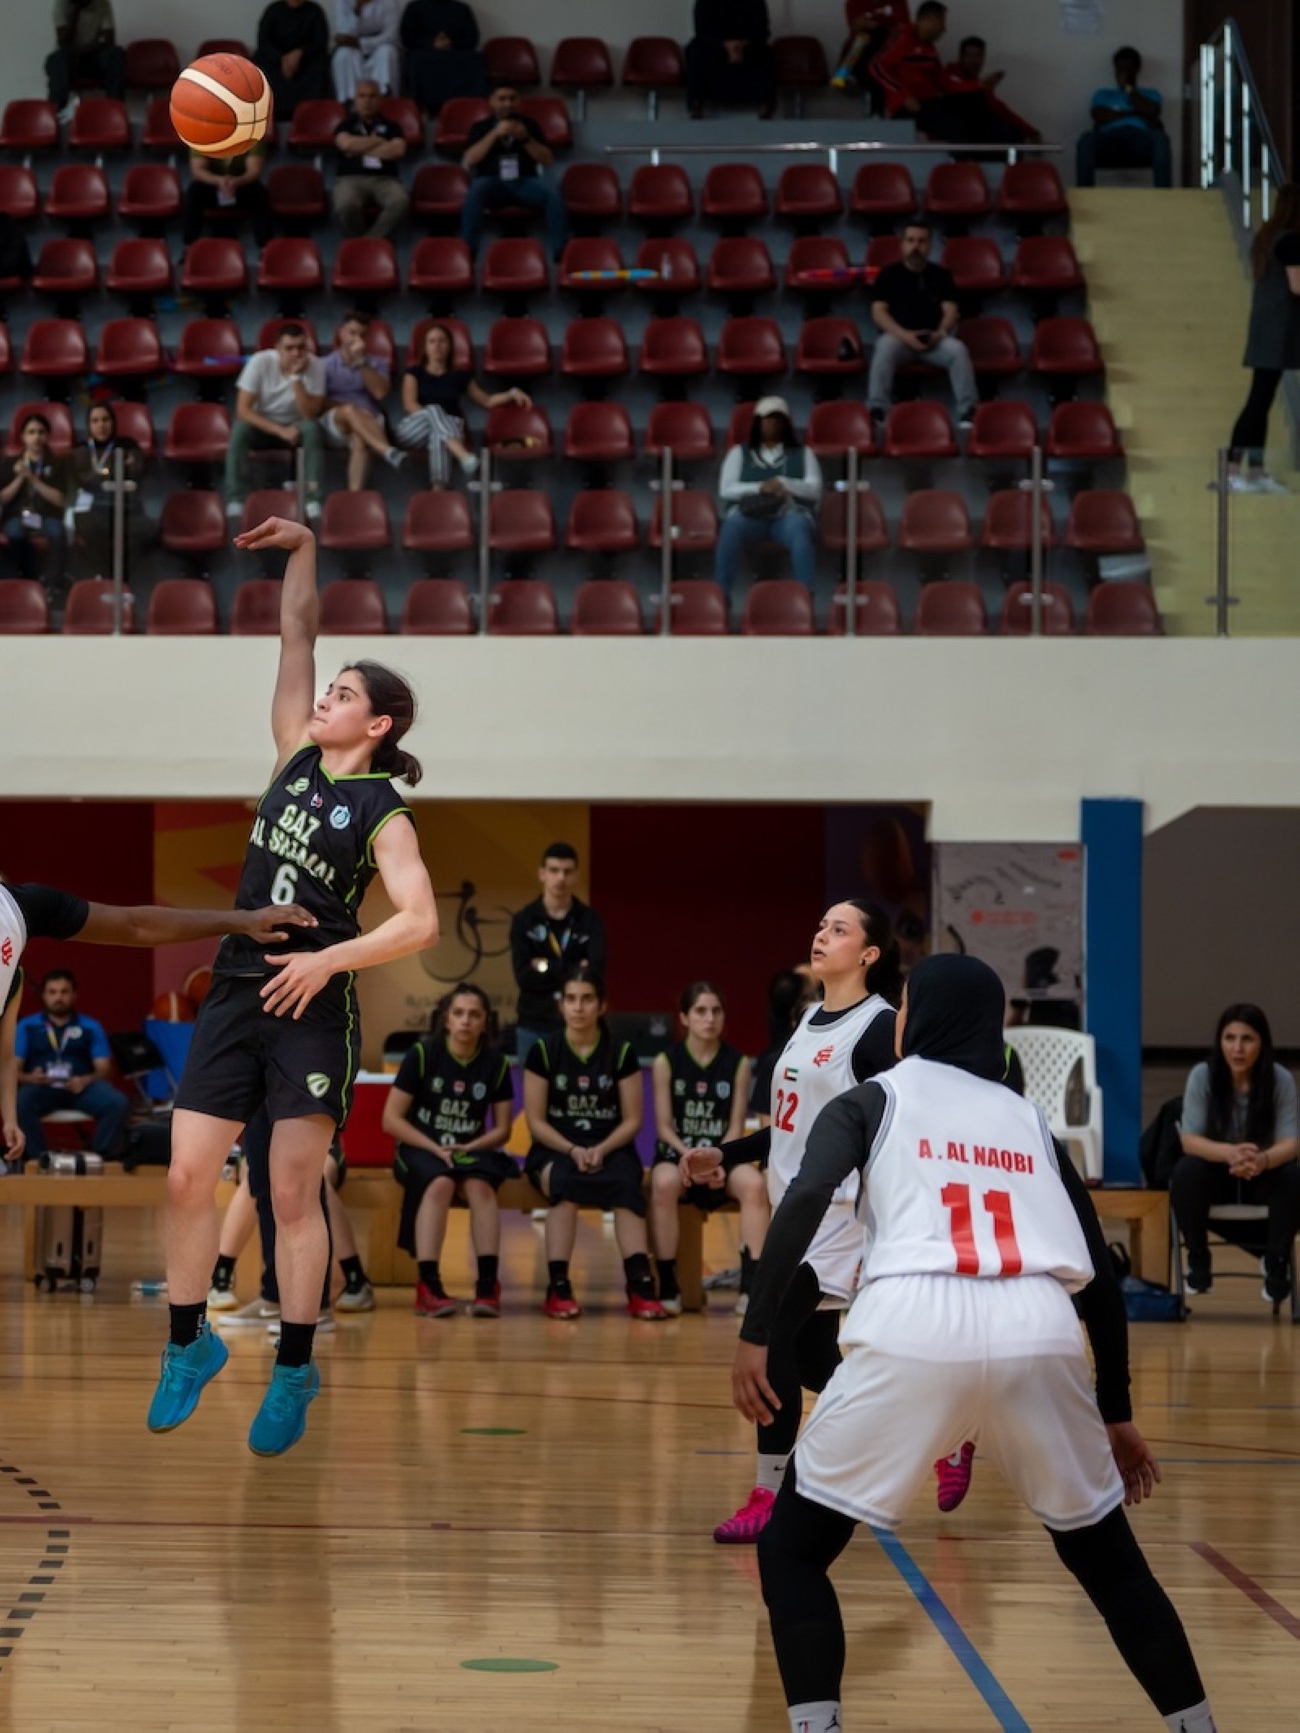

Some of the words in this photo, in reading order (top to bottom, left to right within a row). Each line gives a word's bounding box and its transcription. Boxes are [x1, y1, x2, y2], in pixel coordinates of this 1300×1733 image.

[278, 804, 321, 848] GAZ
[271, 863, 299, 906] 6
[440, 1097, 471, 1119] GAZ
[684, 1099, 716, 1119] GAZ
[947, 1141, 969, 1163] AL
[973, 1145, 1034, 1175] NAQBI
[940, 1182, 1023, 1277] 11
